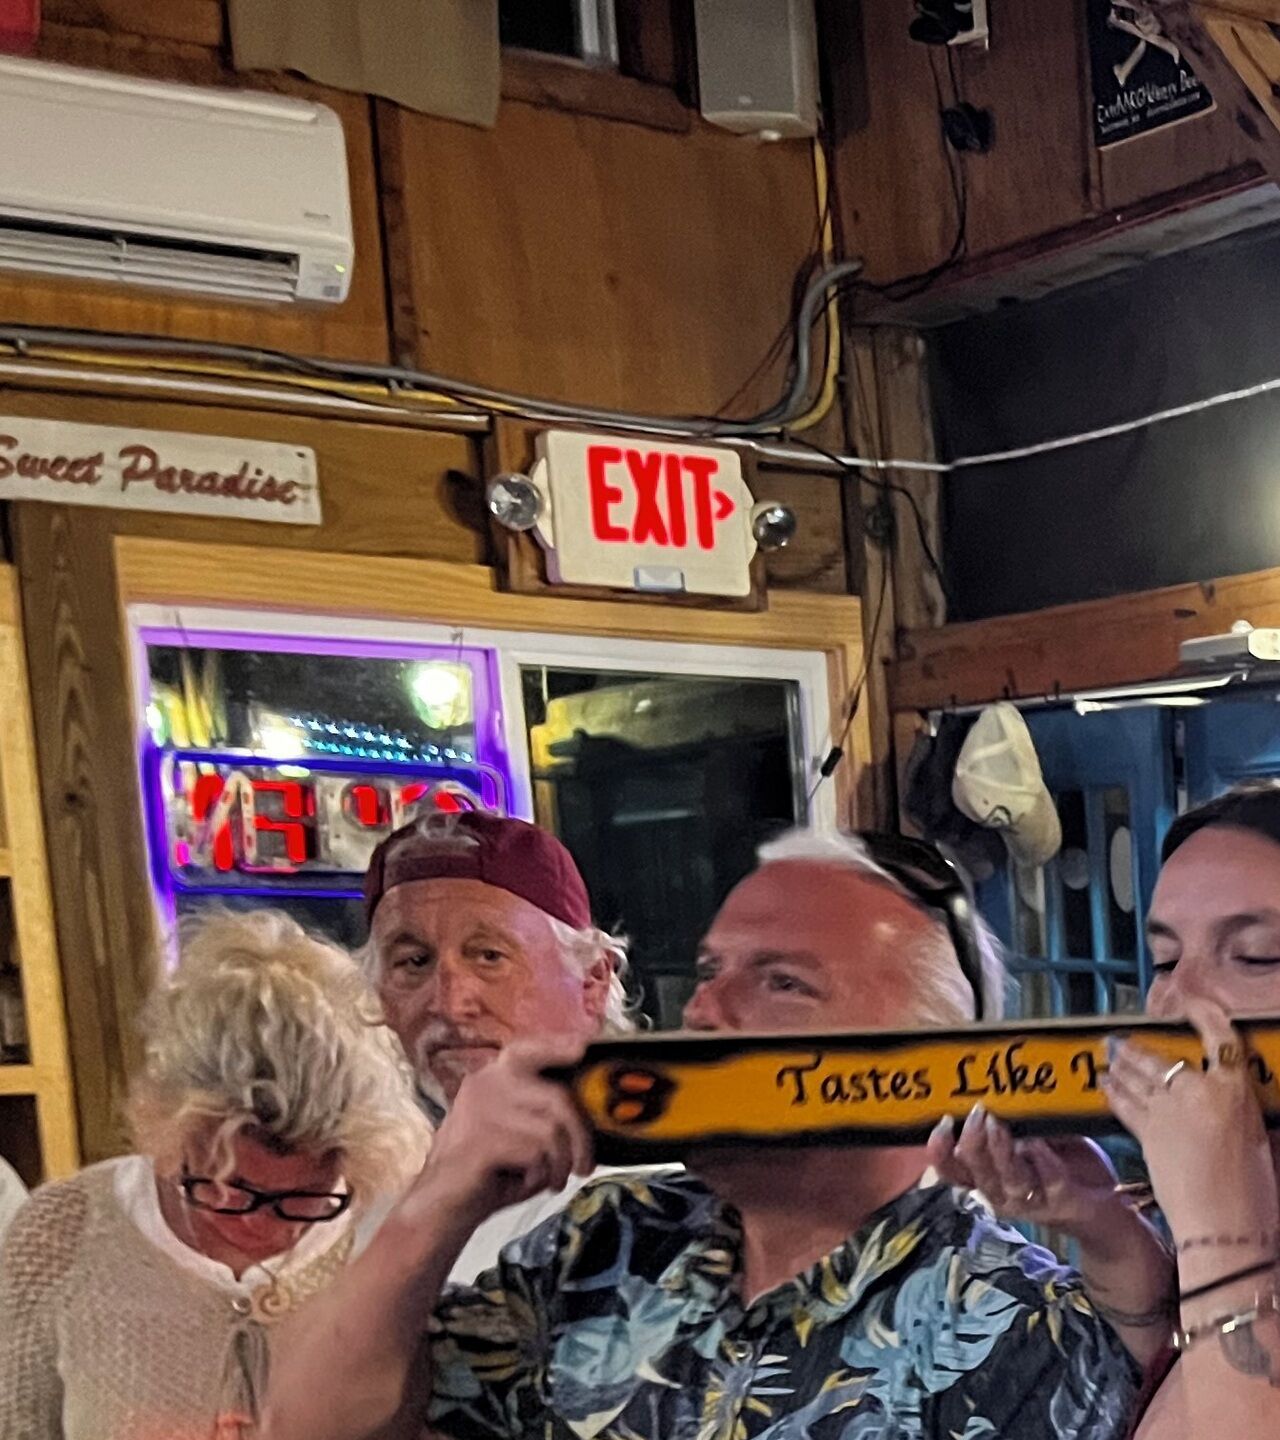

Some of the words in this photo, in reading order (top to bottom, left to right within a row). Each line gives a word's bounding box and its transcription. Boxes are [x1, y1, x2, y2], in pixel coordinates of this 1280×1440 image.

[0, 434, 103, 484] Sweet
[118, 444, 311, 504] Paradise
[587, 445, 719, 550] EXIT
[776, 1049, 932, 1106] Tastes
[951, 1037, 1058, 1097] Like
